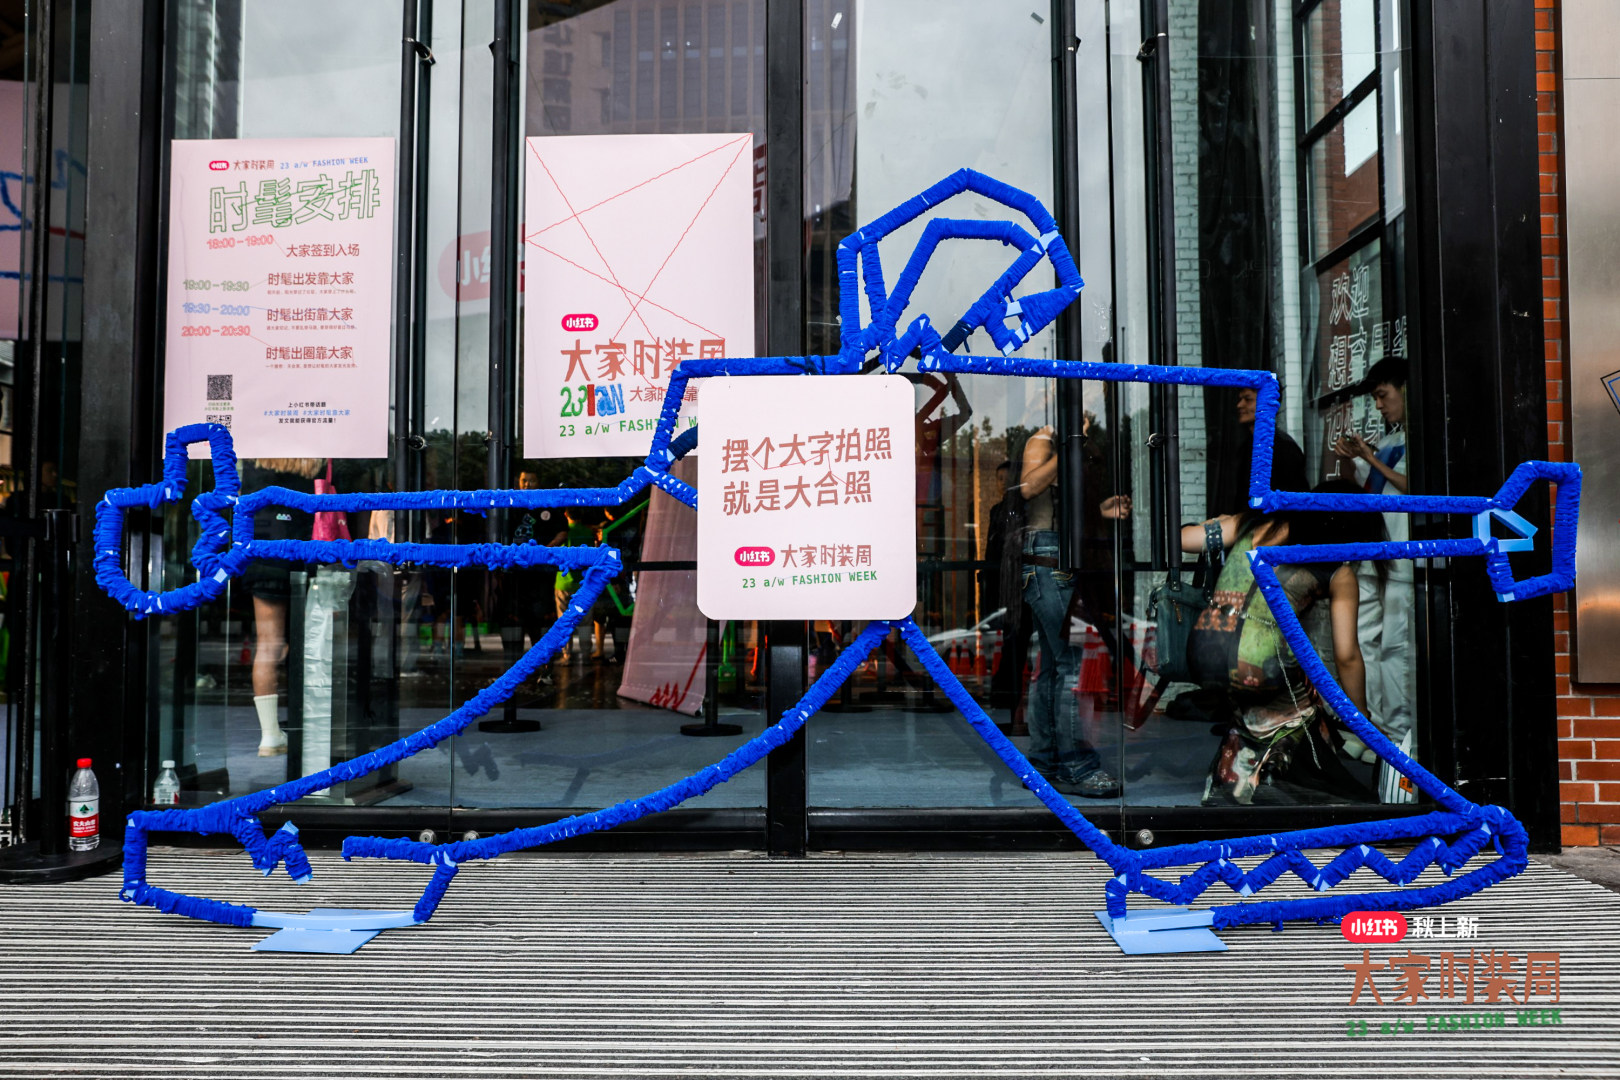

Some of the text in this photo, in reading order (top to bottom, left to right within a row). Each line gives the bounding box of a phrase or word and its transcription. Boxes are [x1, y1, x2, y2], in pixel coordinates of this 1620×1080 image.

[234, 160, 274, 170] 大家时装周
[280, 162, 290, 170] 23
[294, 161, 308, 170] a/w
[312, 158, 345, 168] FASHION
[350, 156, 368, 164] WEEK
[209, 168, 380, 234] 时髦安排
[286, 244, 360, 258] 大家签到入场
[268, 272, 354, 286] 时髦出发靠大家
[1330, 266, 1370, 325] 欢迎
[267, 308, 353, 322] 时髦出街靠大家
[266, 346, 352, 360] 时髦出圈靠大家
[629, 386, 698, 402] 大家靠
[559, 425, 576, 437] 23
[585, 422, 610, 436] a/w
[620, 418, 680, 432] FASH
[722, 427, 892, 474] 摆个大字拍照
[723, 470, 872, 516] 就是大合照
[780, 544, 872, 568] 大家时装周
[742, 570, 878, 588] 23 a/w FASHION WEEK
